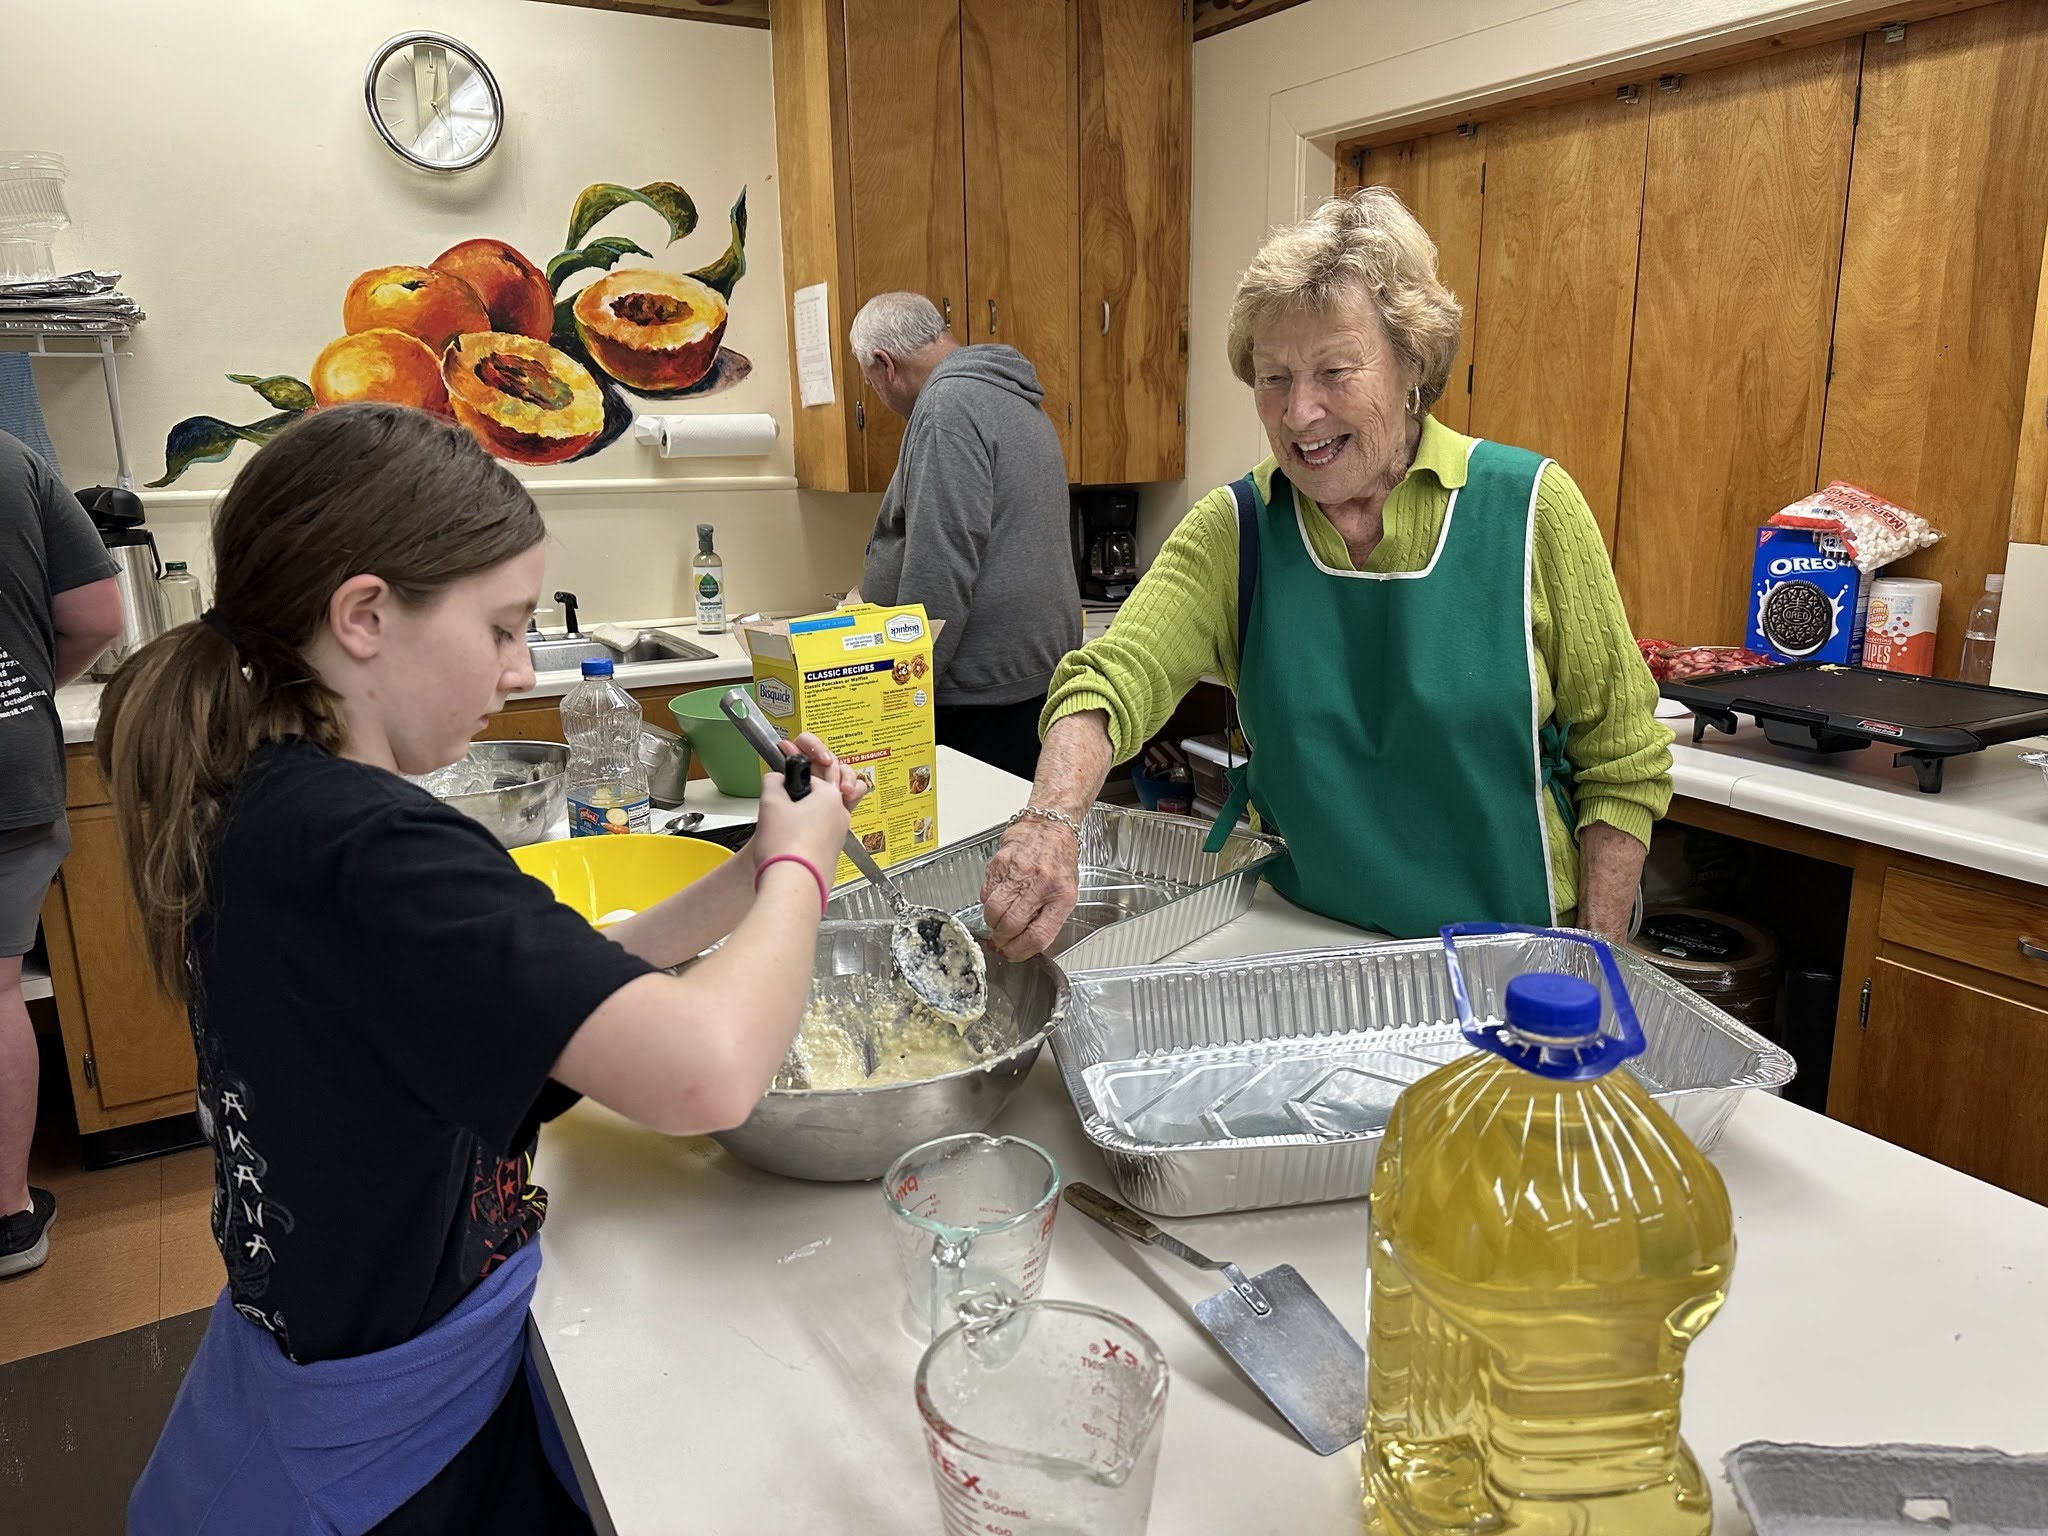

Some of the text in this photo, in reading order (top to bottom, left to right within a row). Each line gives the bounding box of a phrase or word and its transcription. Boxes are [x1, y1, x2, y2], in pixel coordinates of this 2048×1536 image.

[1827, 497, 1858, 510] Mini
[1824, 538, 1836, 547] 12
[1769, 557, 1837, 576] OREO
[1785, 610, 1808, 620] OREO
[890, 624, 920, 637] Bisquick
[807, 664, 875, 681] CLASSIC RECIPES
[760, 683, 791, 704] Bisquick
[827, 734, 845, 742] Classic
[851, 754, 860, 763] TO
[861, 750, 888, 761] BISQUICK
[1648, 928, 1729, 955] EcoSmart
